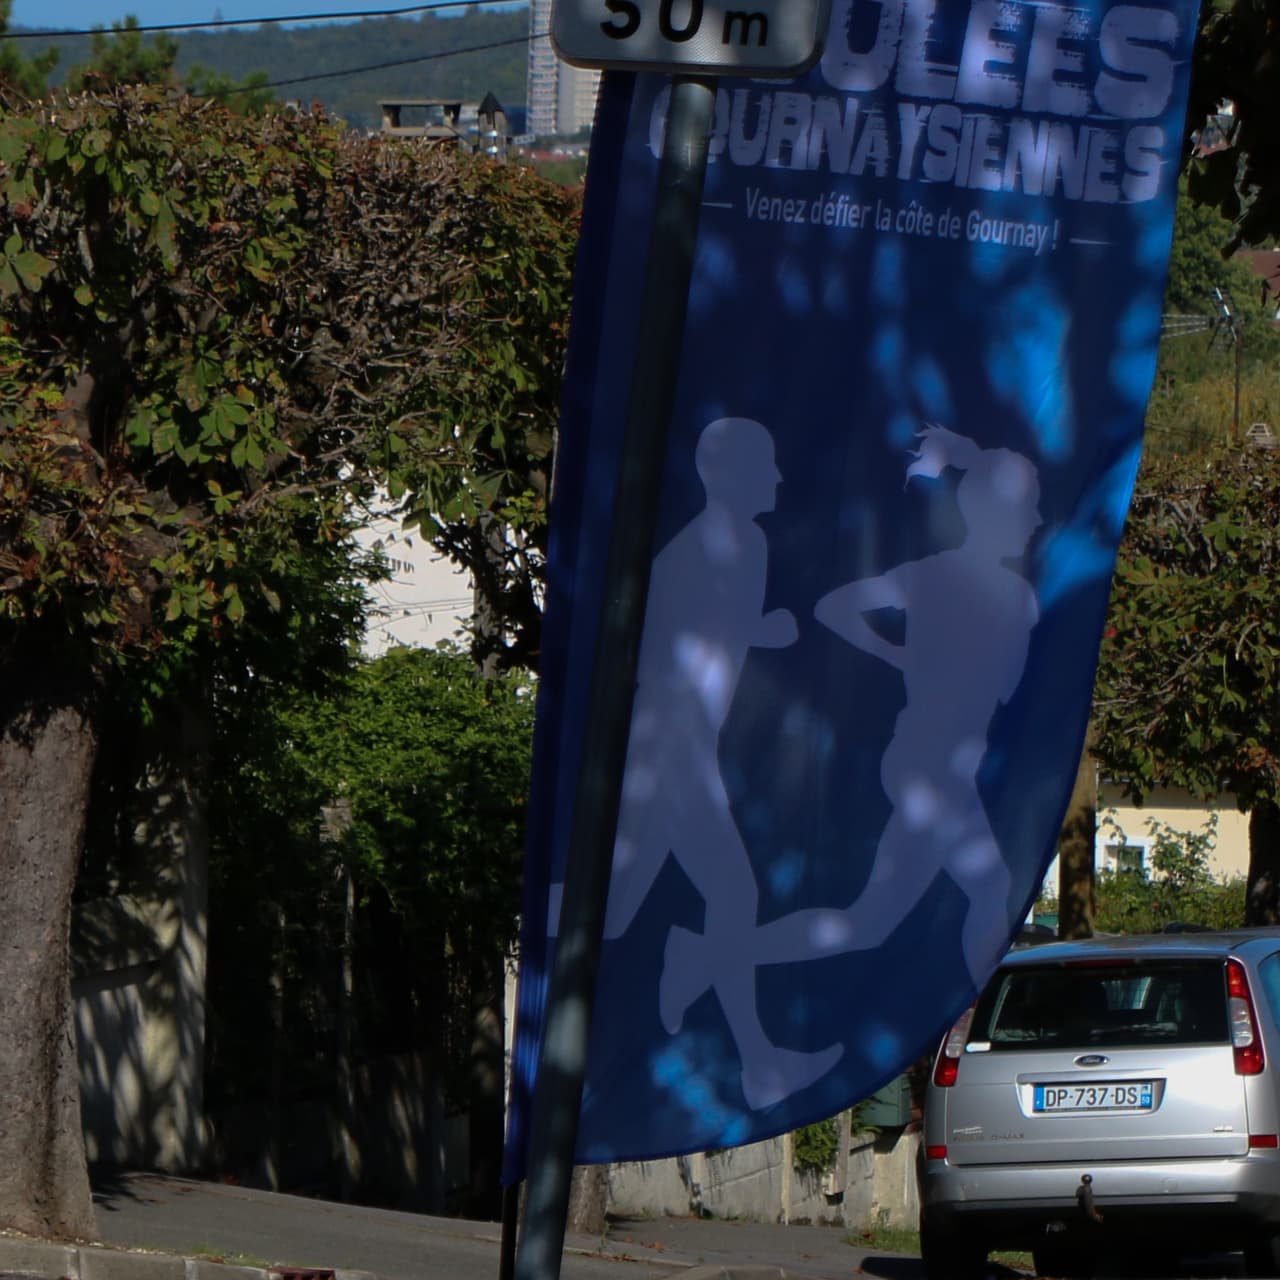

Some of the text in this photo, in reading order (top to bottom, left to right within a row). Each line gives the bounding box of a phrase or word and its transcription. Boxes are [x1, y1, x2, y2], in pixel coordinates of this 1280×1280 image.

[722, 9, 769, 47] m
[820, 0, 1180, 120] ULEES
[745, 186, 806, 223] Venez
[810, 191, 871, 229] défier
[875, 200, 890, 231] la
[896, 200, 932, 237] côte
[939, 209, 960, 239] de
[966, 209, 1048, 255] Gournay
[1045, 1086, 1138, 1107] DP-737-DS
